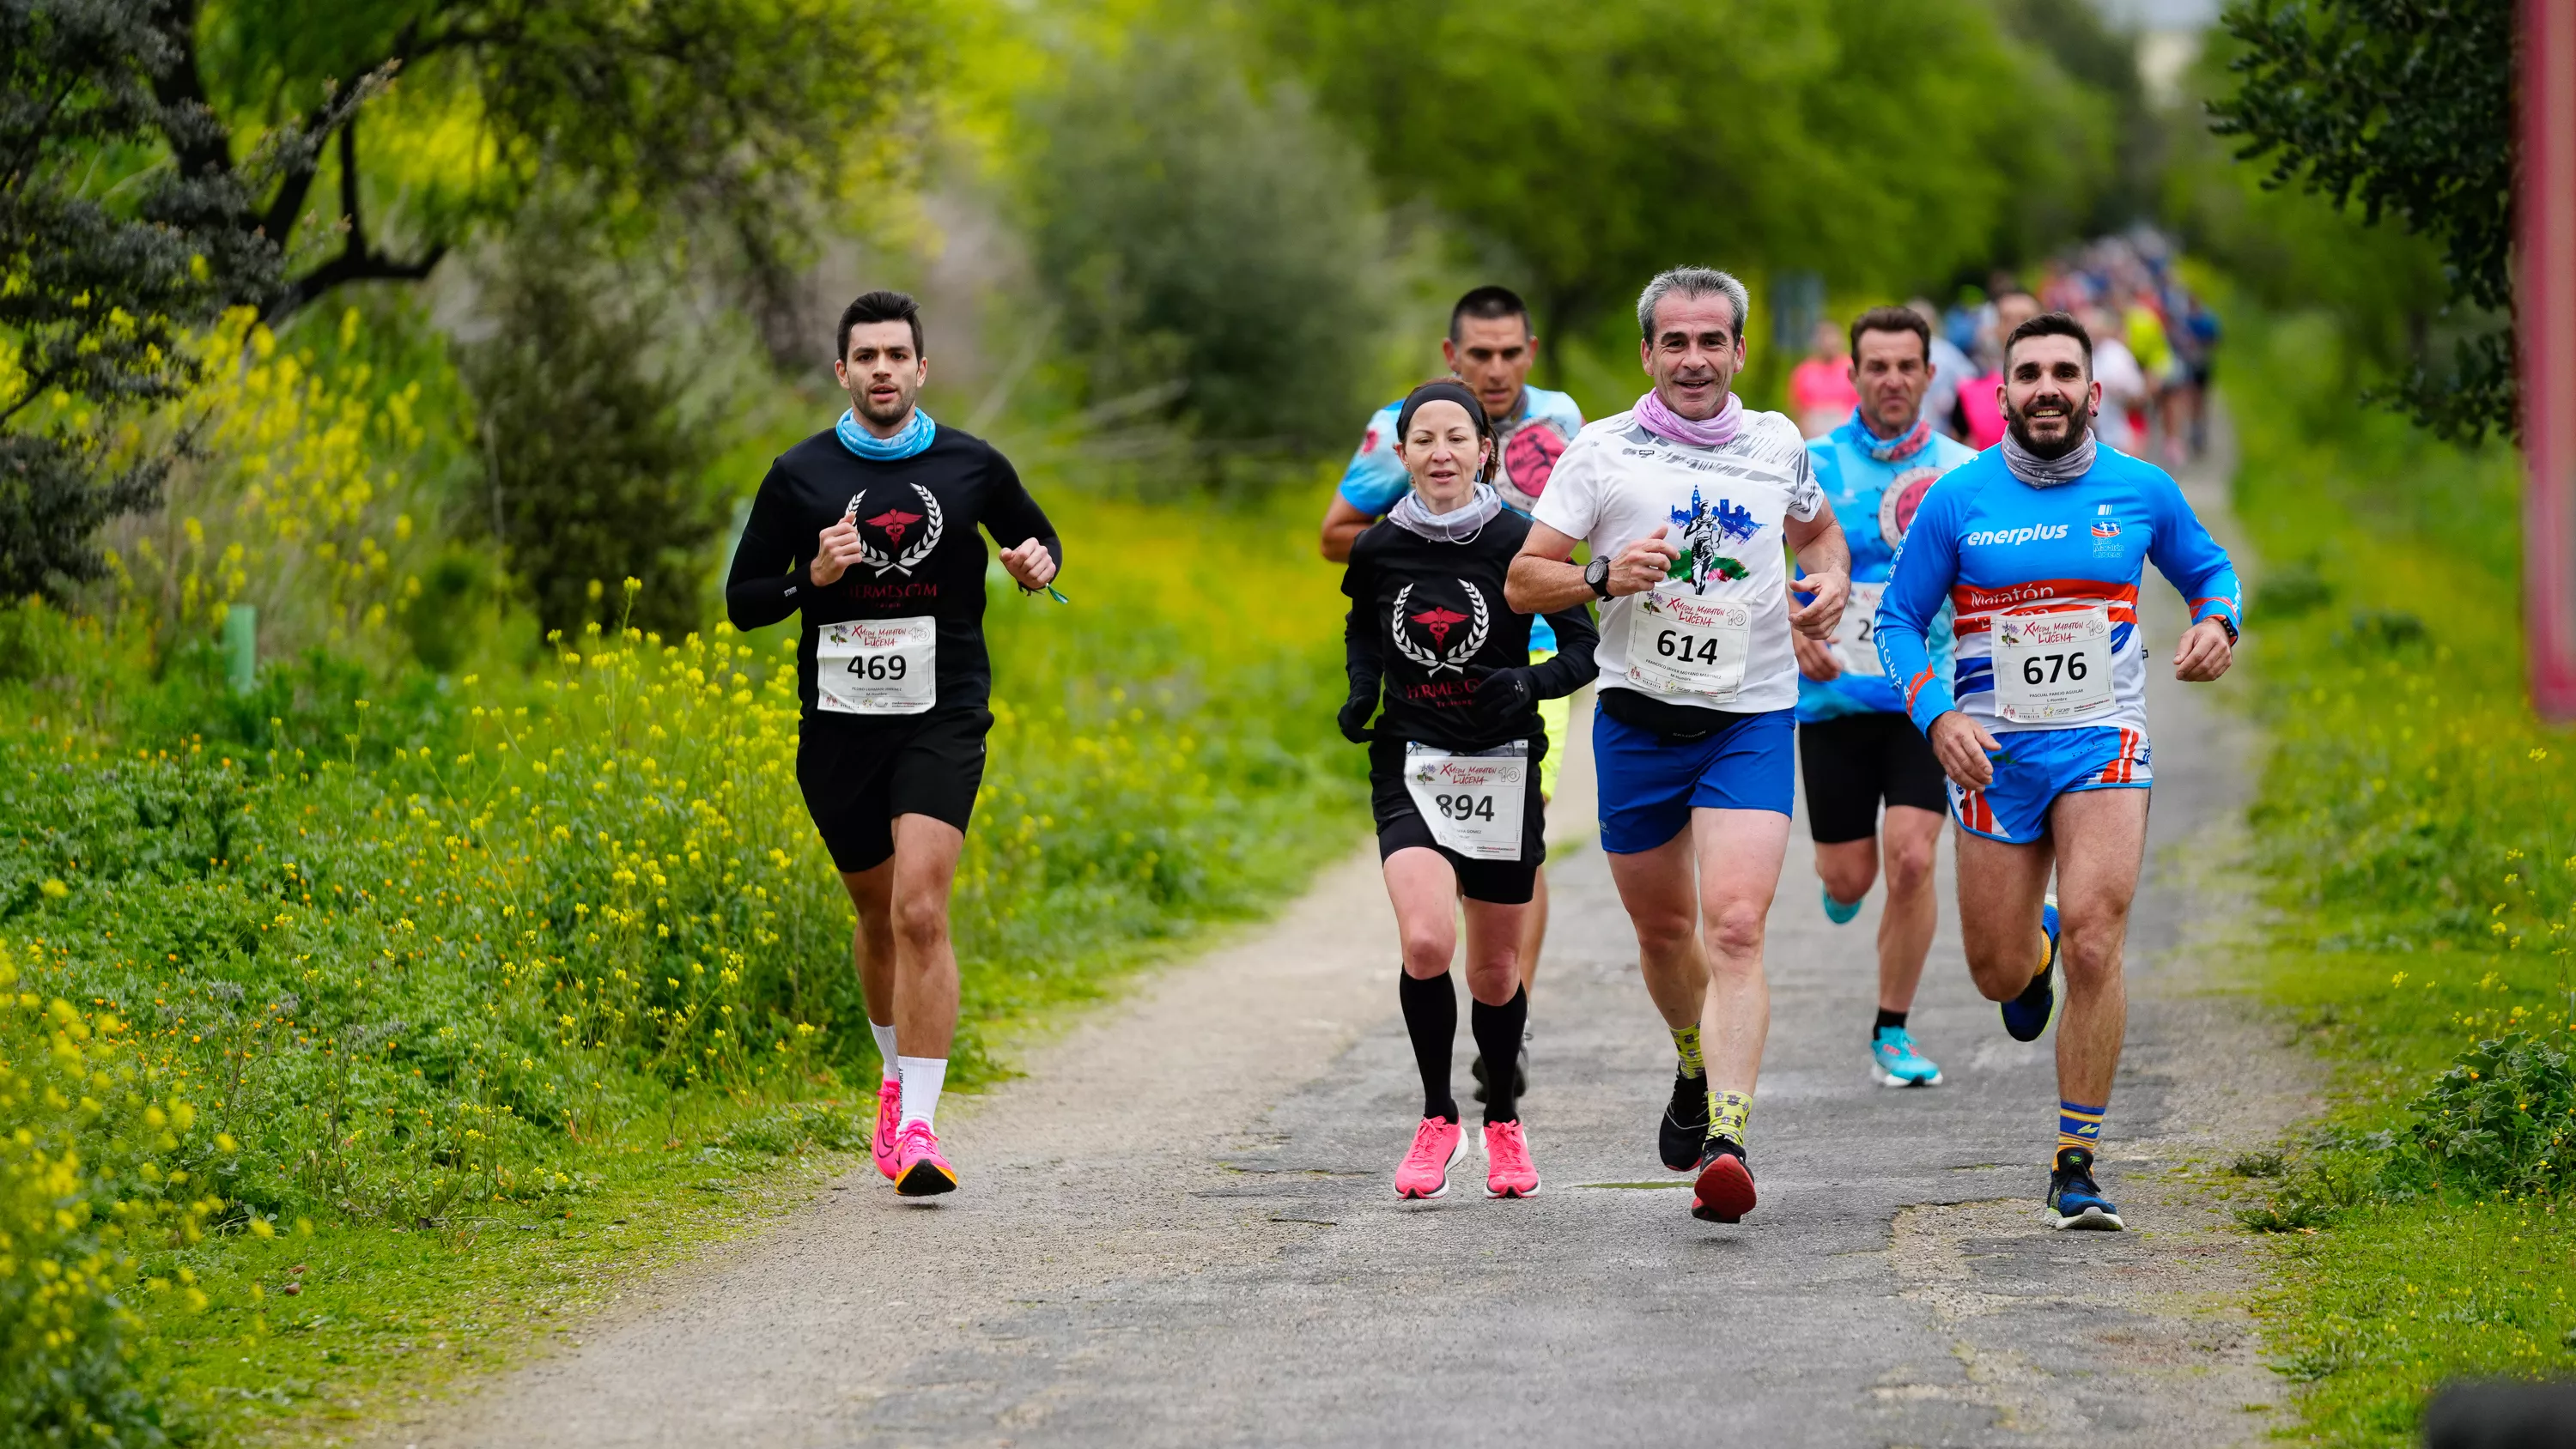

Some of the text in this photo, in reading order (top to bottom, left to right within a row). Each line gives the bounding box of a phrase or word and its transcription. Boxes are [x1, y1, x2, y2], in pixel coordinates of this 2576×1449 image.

[1967, 524, 2069, 546] enerplus
[1971, 584, 2054, 609] Maratón
[1679, 611, 1715, 627] LUCENA
[865, 637, 899, 646] LUCENA
[1657, 630, 1718, 665] 614
[2038, 633, 2077, 644] LUCENA
[847, 655, 907, 680] 469
[2023, 652, 2087, 684] 676
[1453, 775, 1489, 785] LUCENA
[1436, 794, 1494, 822] 894
